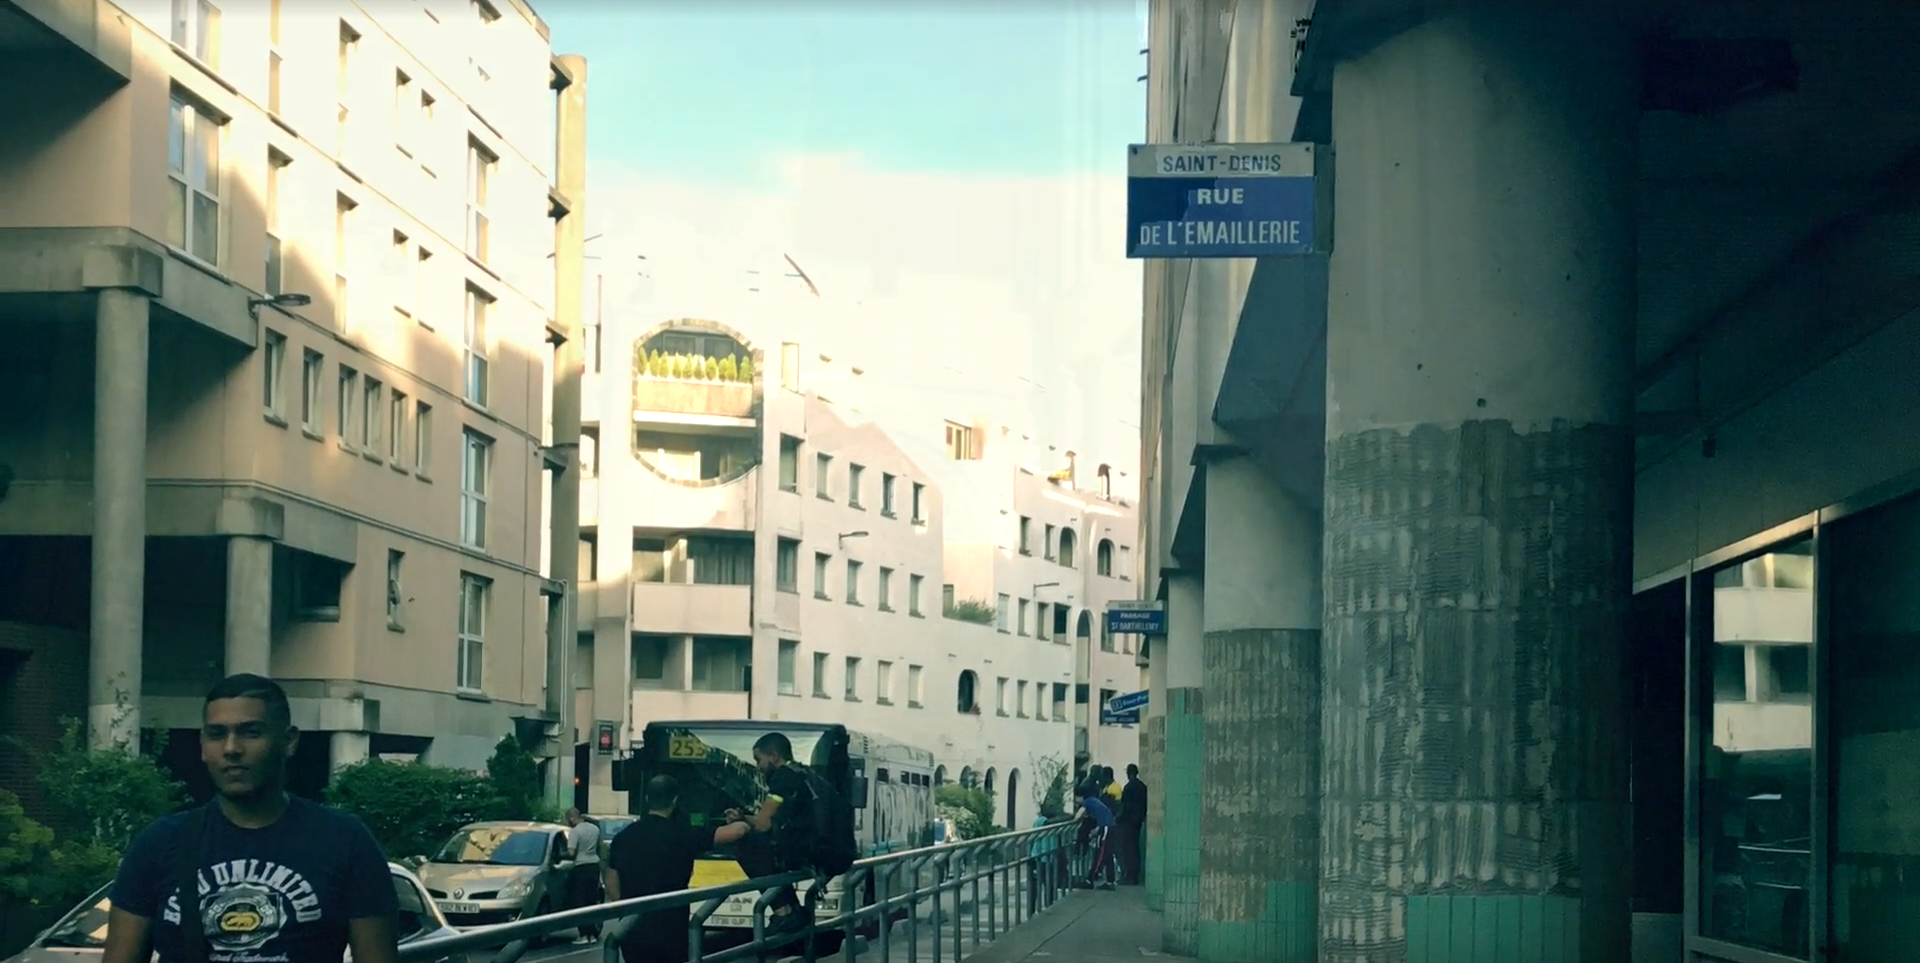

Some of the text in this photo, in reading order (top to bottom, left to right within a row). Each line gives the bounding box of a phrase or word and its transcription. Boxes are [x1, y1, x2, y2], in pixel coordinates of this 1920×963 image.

[1163, 154, 1281, 173] SAINT-DENIS
[1197, 188, 1244, 204] RUE
[1140, 220, 1300, 246] DE L'EMAILLERIE
[672, 741, 706, 757] 253
[211, 858, 322, 923] UNLIMITED
